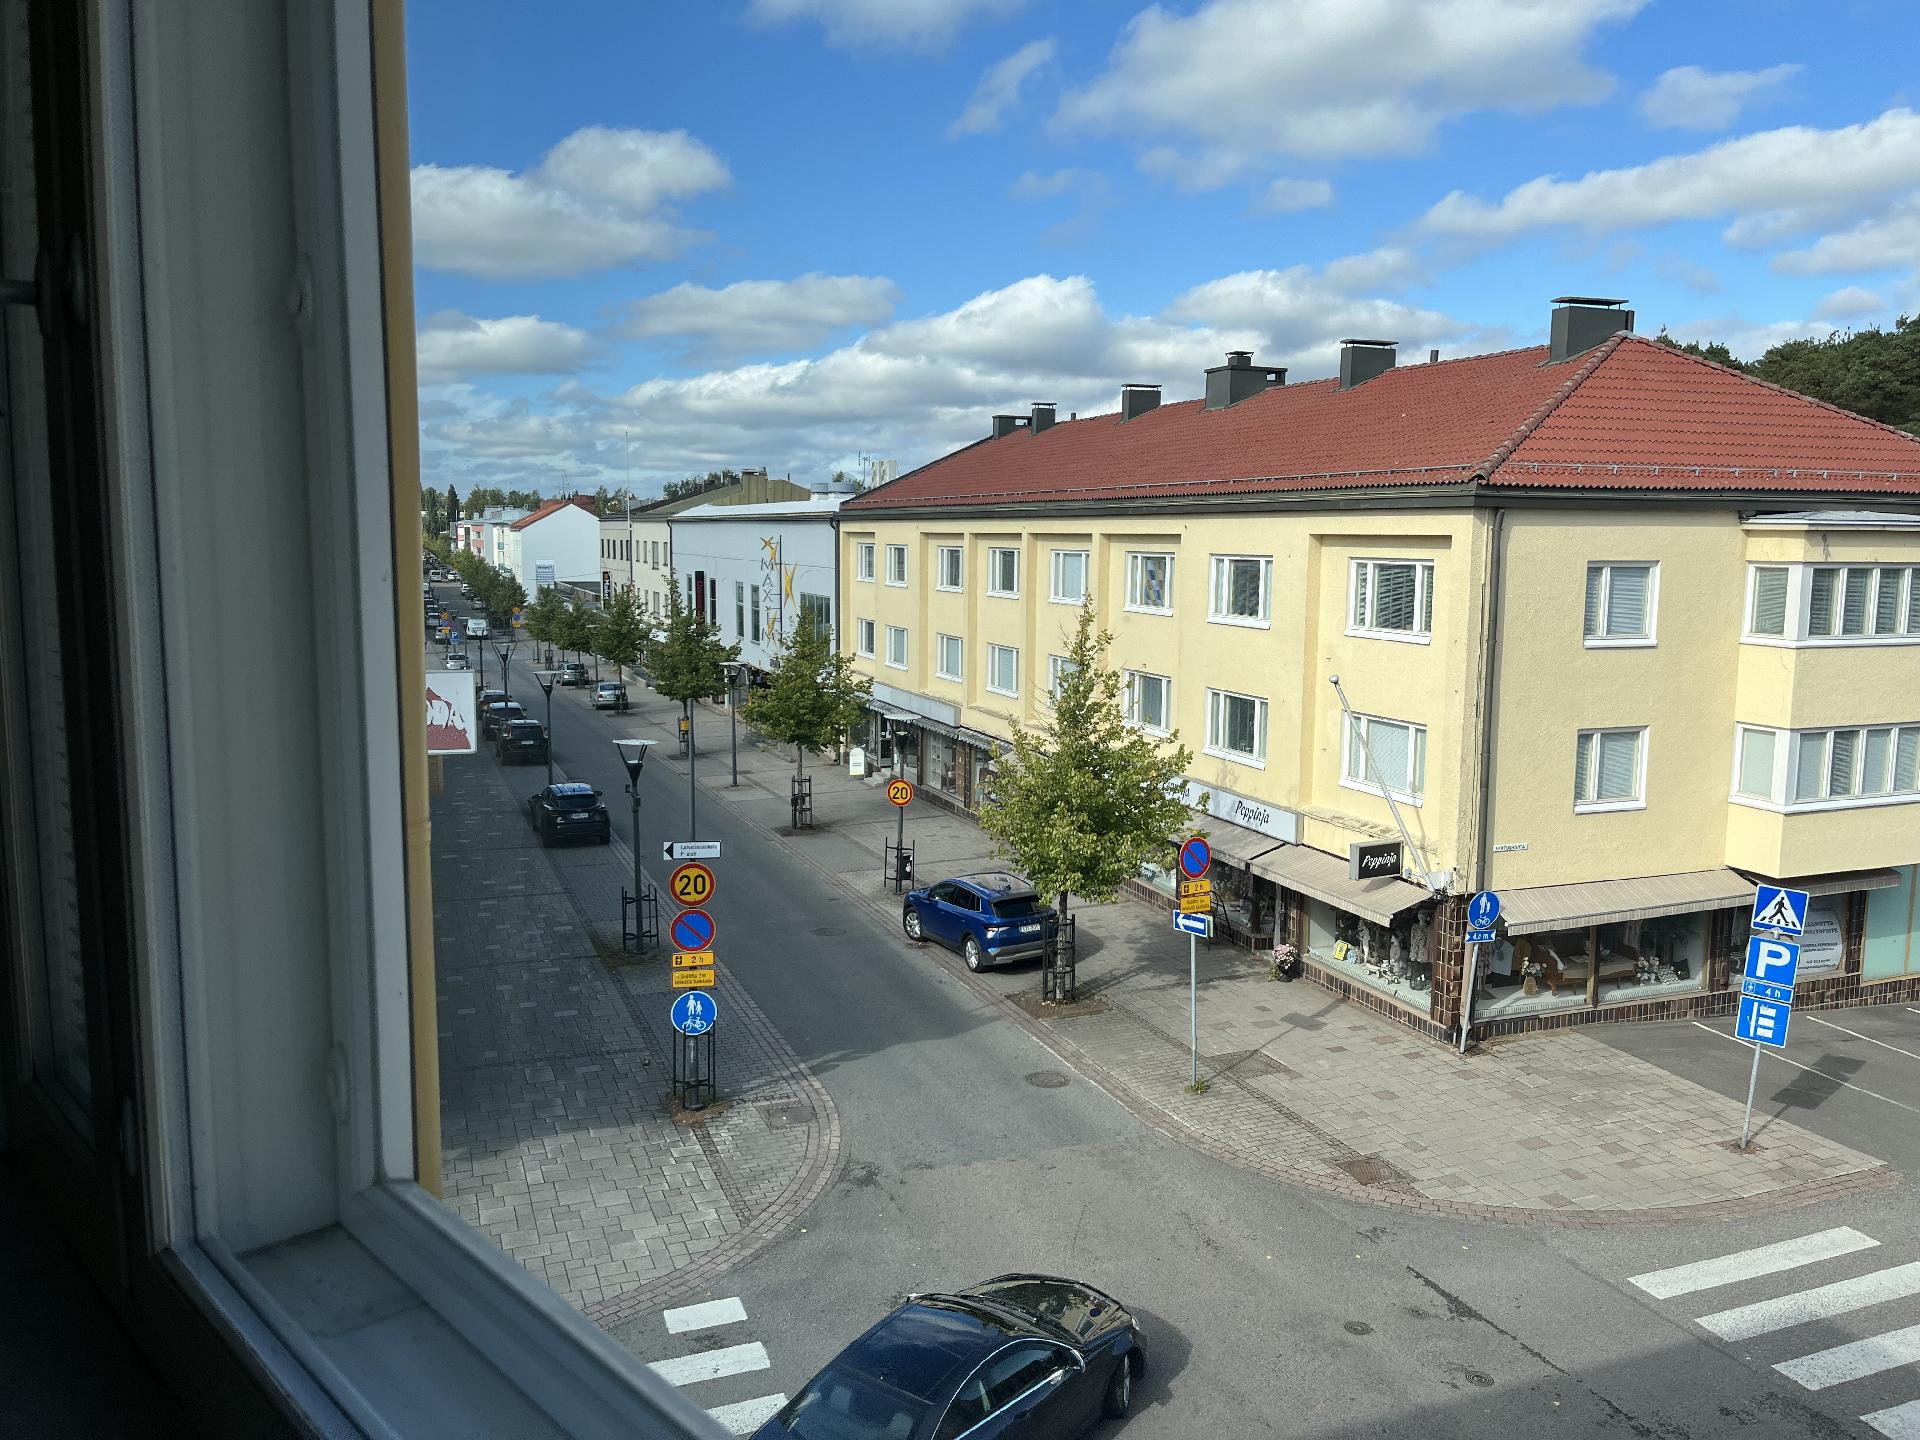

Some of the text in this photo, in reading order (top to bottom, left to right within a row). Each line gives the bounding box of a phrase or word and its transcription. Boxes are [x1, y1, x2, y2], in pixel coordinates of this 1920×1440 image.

[893, 787, 908, 799] 20
[1235, 800, 1269, 826] Peppinja
[1361, 852, 1397, 869] Peppinja
[679, 874, 706, 896] 20
[1194, 884, 1199, 892] 2
[1756, 941, 1791, 978] P
[1765, 987, 1780, 998] 4 h
